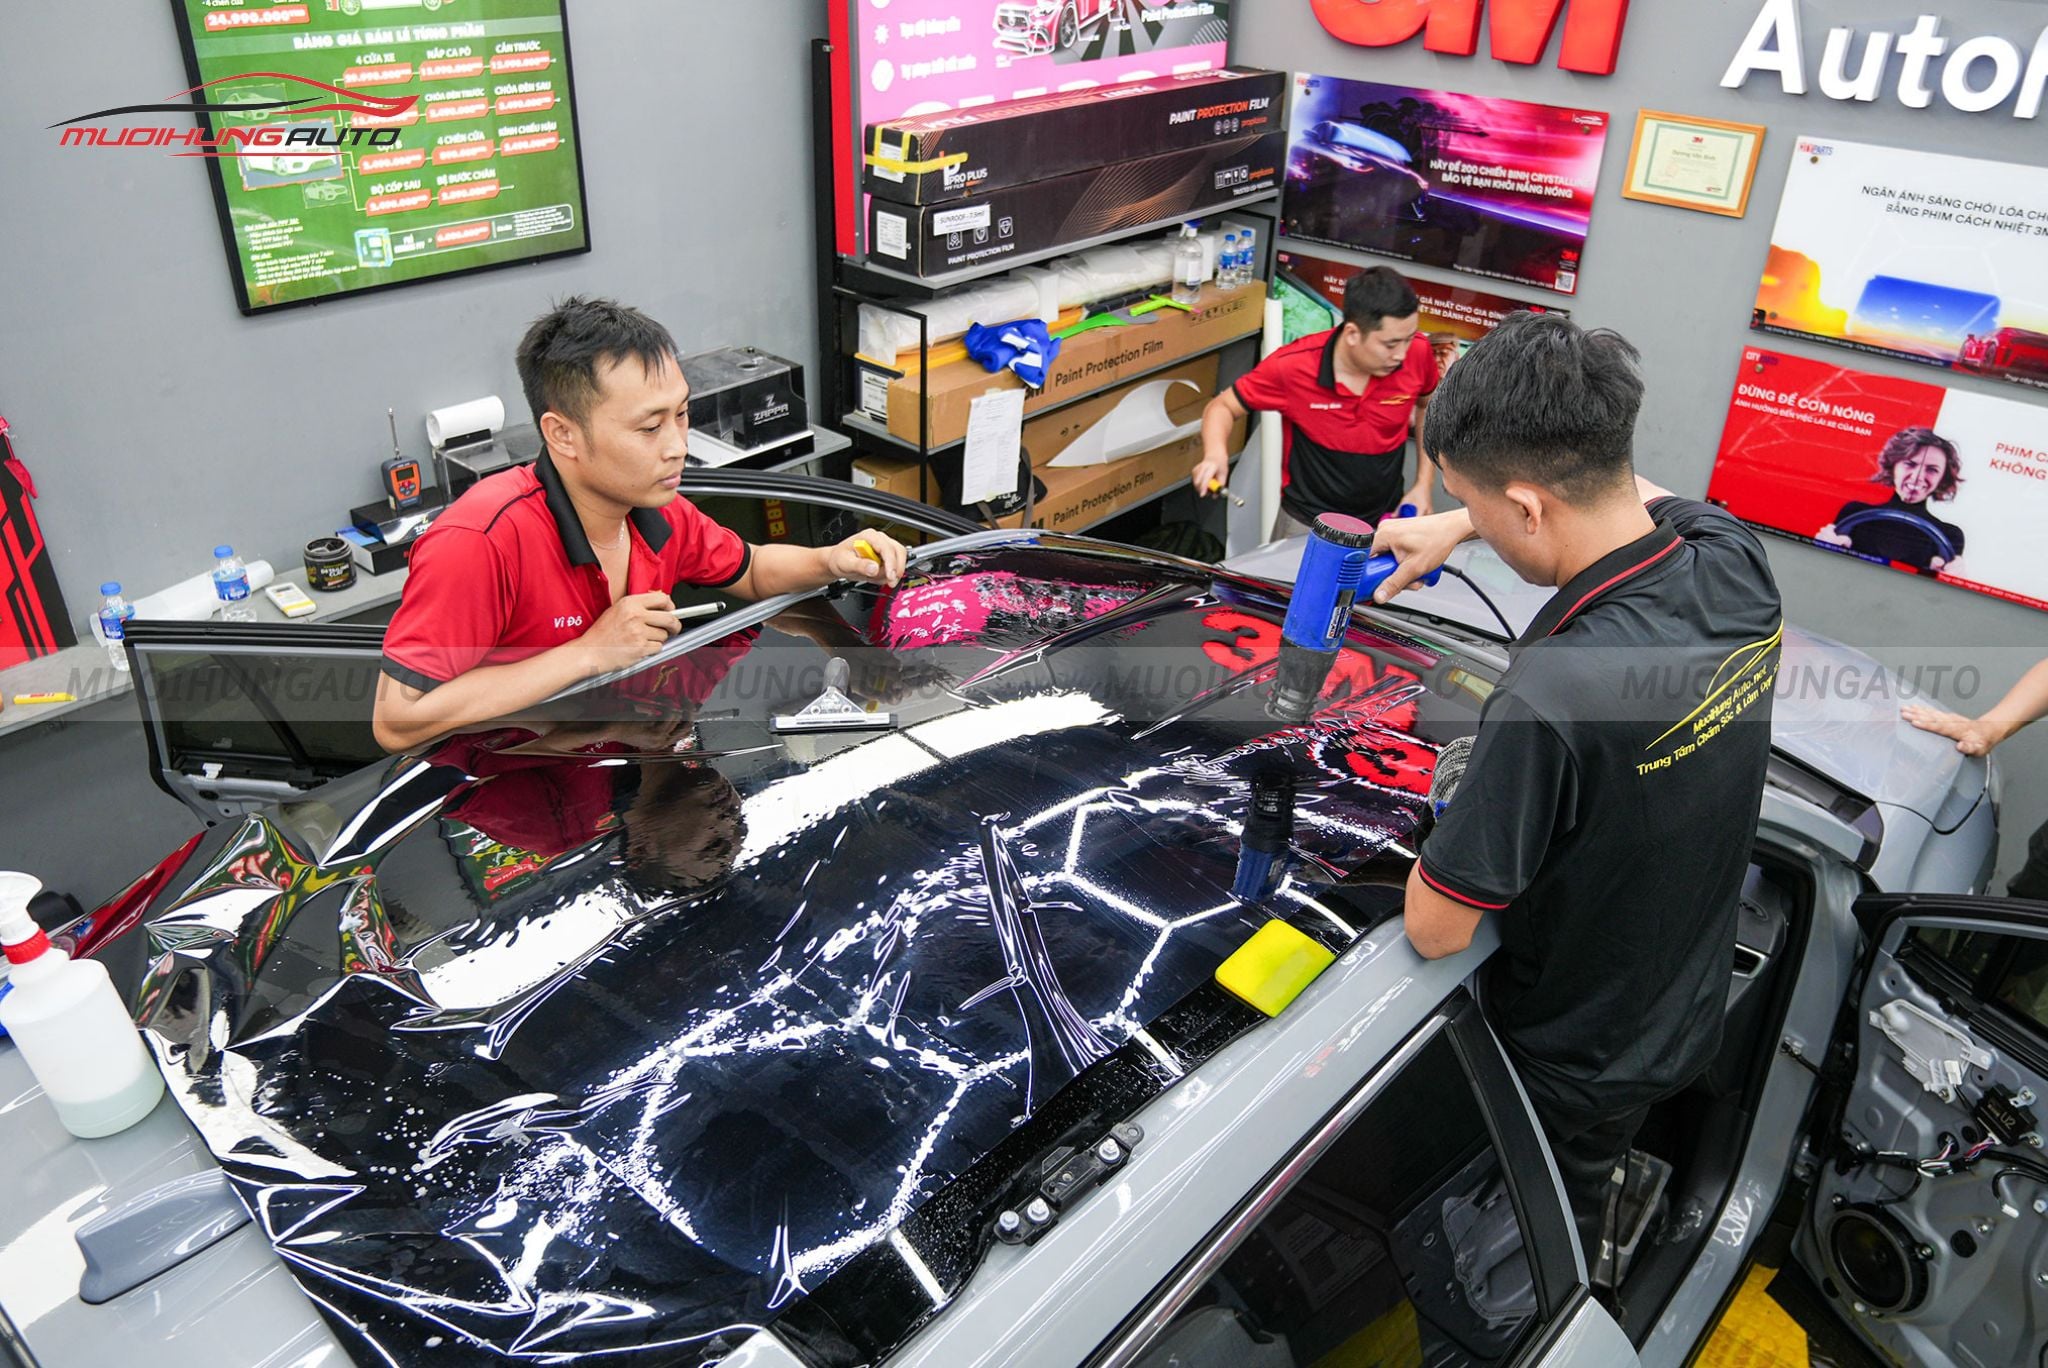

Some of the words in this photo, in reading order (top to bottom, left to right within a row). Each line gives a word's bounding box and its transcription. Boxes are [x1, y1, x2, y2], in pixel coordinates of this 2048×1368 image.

[336, 30, 362, 46] GIÁ
[355, 56, 363, 65] 4
[385, 53, 396, 62] XE
[446, 48, 458, 58] CA
[1169, 110, 1196, 125] PAINT
[1197, 101, 1248, 120] PROTECTION
[1249, 97, 1270, 111] FILM
[950, 172, 967, 185] PRO
[967, 168, 988, 181] PLUS
[1461, 163, 1478, 174] 200
[1479, 164, 1507, 178] CHIẾN
[1507, 168, 1530, 181] BINH
[403, 179, 421, 190] SAU
[1441, 173, 1460, 184] BẢO
[1461, 175, 1472, 187] VỆ
[1473, 177, 1491, 189] BẠN
[1544, 185, 1573, 198] NÓNG
[1861, 184, 1896, 199] NGĂN
[1898, 189, 1925, 204] ÁNH
[1927, 194, 1961, 209] SÁNG
[1964, 199, 1996, 215] CHÓI
[1998, 204, 2024, 218] LÓA
[1885, 202, 1919, 217] BẰNG
[1921, 209, 1952, 222] PHIM
[1955, 212, 1991, 228] CÁCH
[1994, 219, 2031, 235] NHIỆT
[948, 255, 966, 265] PAINT
[967, 248, 1001, 261] PROTECTION
[1001, 243, 1015, 253] FILM
[1442, 309, 1463, 321] DÀNH
[1465, 315, 1482, 325] CHO
[1455, 303, 1473, 313] CHO
[1474, 307, 1488, 317] GIA
[1055, 369, 1082, 387] Paint
[1085, 351, 1140, 375] Protection
[1142, 340, 1164, 356] Film
[753, 403, 789, 421] ZAPPA
[1738, 383, 1776, 402] ĐỪNG
[1778, 391, 1799, 407] ĐỂ
[1798, 397, 1830, 415] CƠN
[1832, 405, 1876, 424] NÓNG
[1814, 415, 1826, 426] LÁI
[1827, 419, 1837, 428] XE
[1837, 421, 1854, 432] CỦA
[1854, 425, 1872, 437] BẠN
[1995, 442, 2033, 460] PHIM
[2035, 451, 2048, 463] C
[1989, 458, 2048, 481] KHÔNG
[1053, 506, 1079, 525] Paint
[1081, 481, 1132, 512] Protection
[1134, 471, 1154, 488] Film
[1733, 664, 1767, 702] Auto.net
[1636, 755, 1672, 776] Trung
[1673, 743, 1695, 761] Tâm
[1696, 724, 1721, 747] Chăm
[1720, 711, 1734, 727] Sóc
[1735, 703, 1742, 714] &
[1743, 688, 1759, 708] Làm
[1760, 674, 1773, 691] Đẹp
